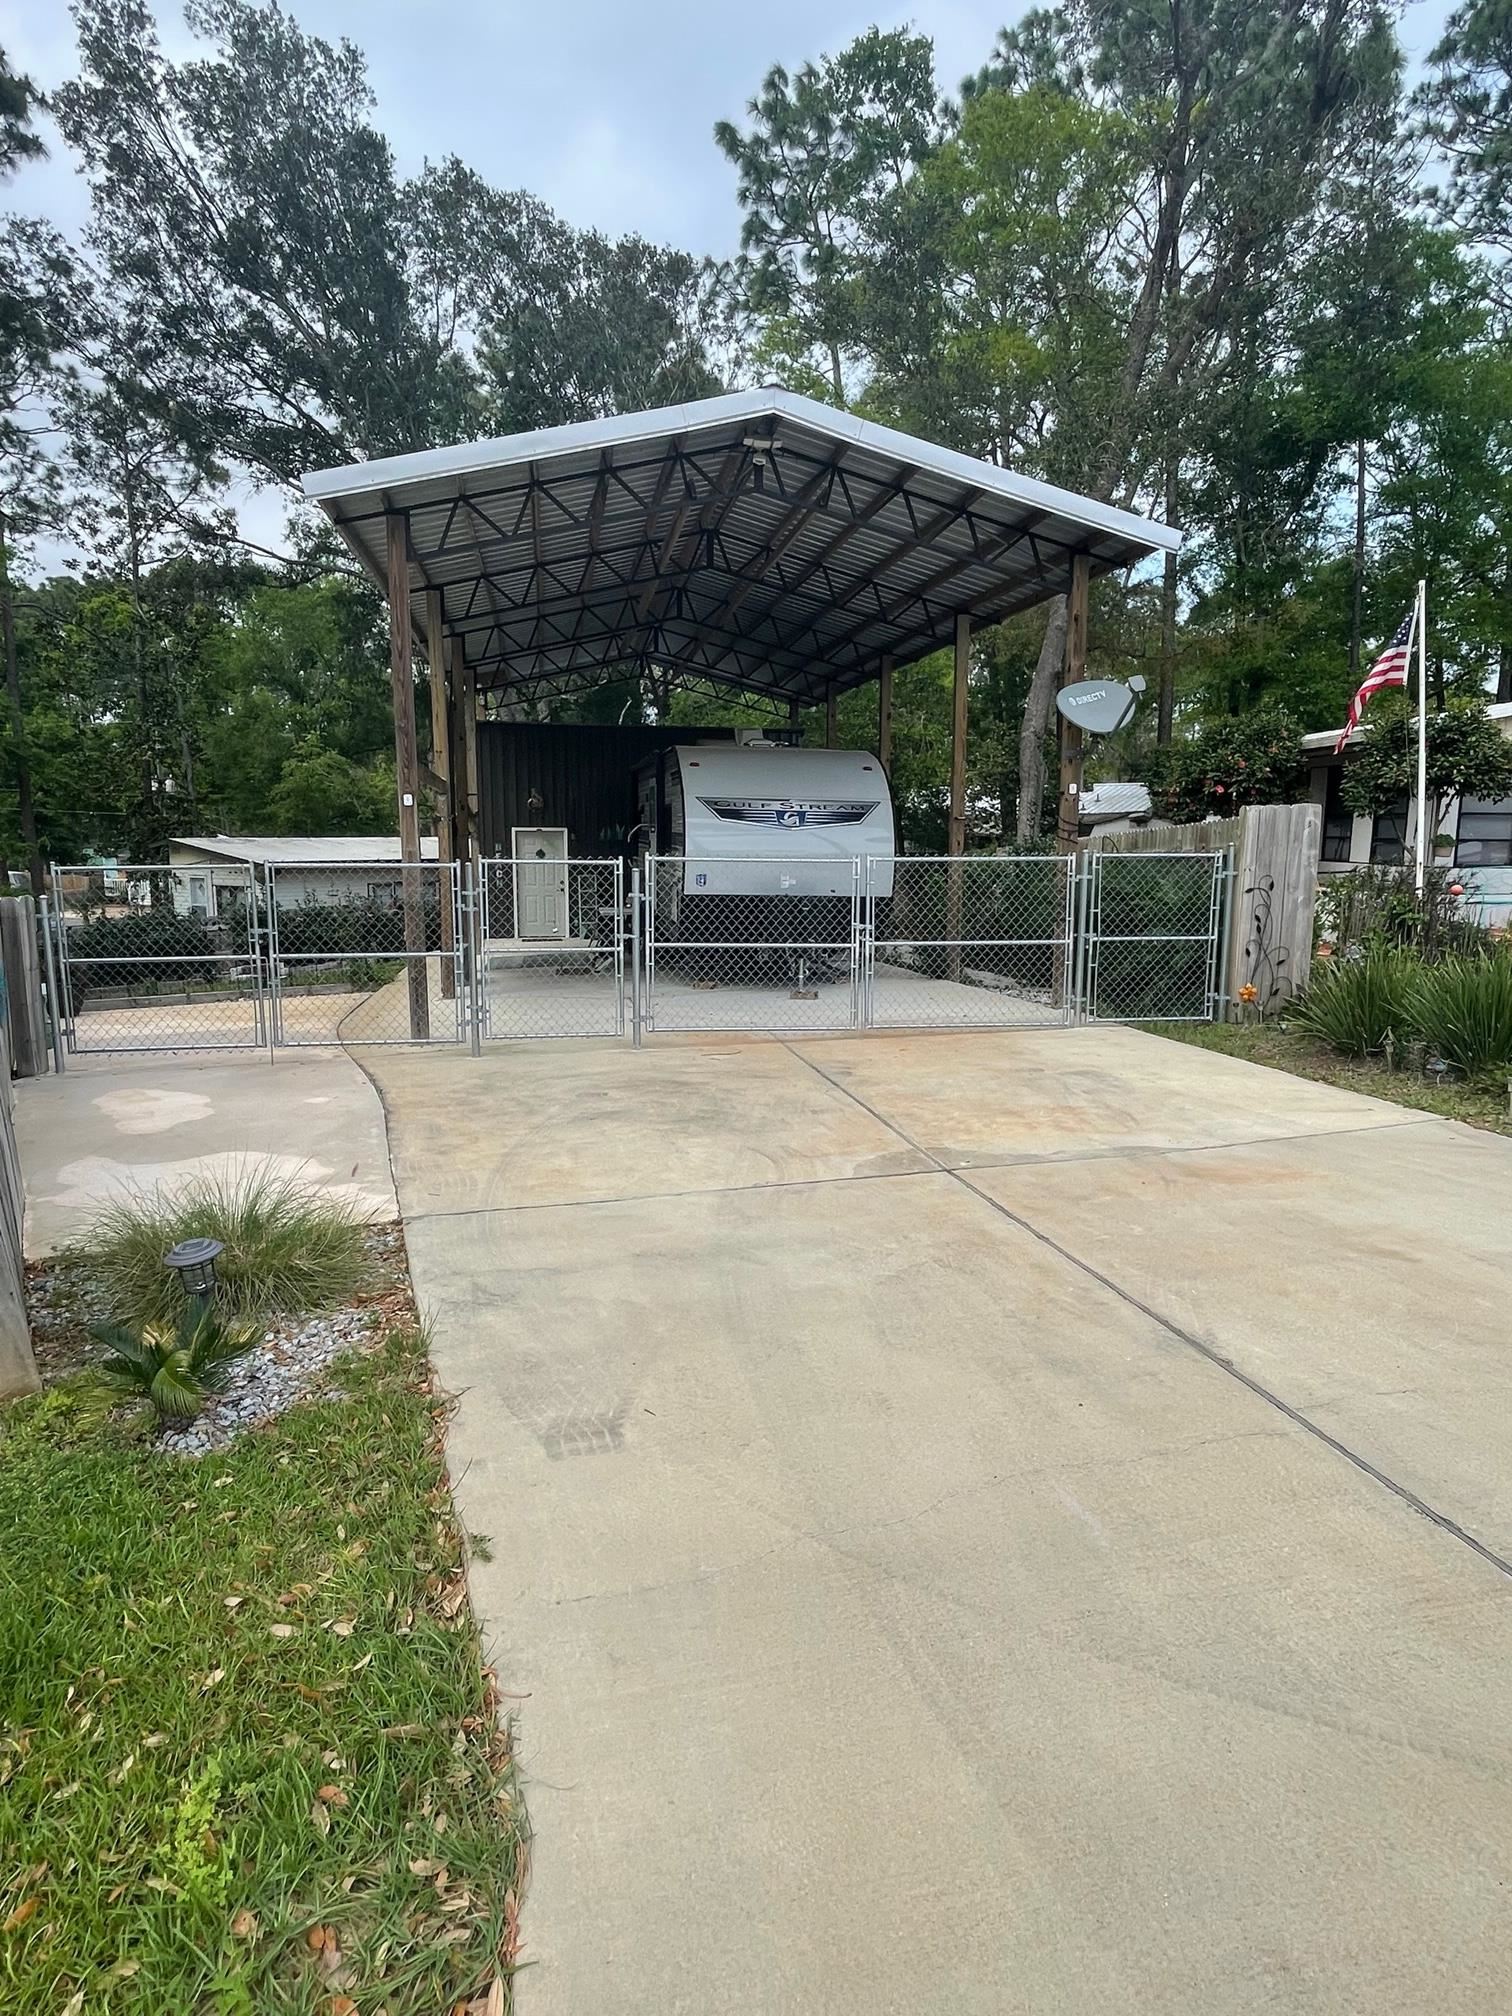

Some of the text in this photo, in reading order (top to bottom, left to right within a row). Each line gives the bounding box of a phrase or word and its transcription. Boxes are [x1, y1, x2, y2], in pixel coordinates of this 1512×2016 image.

[1074, 689, 1106, 705] DIRECTV
[714, 800, 866, 812] GULF STREAM
